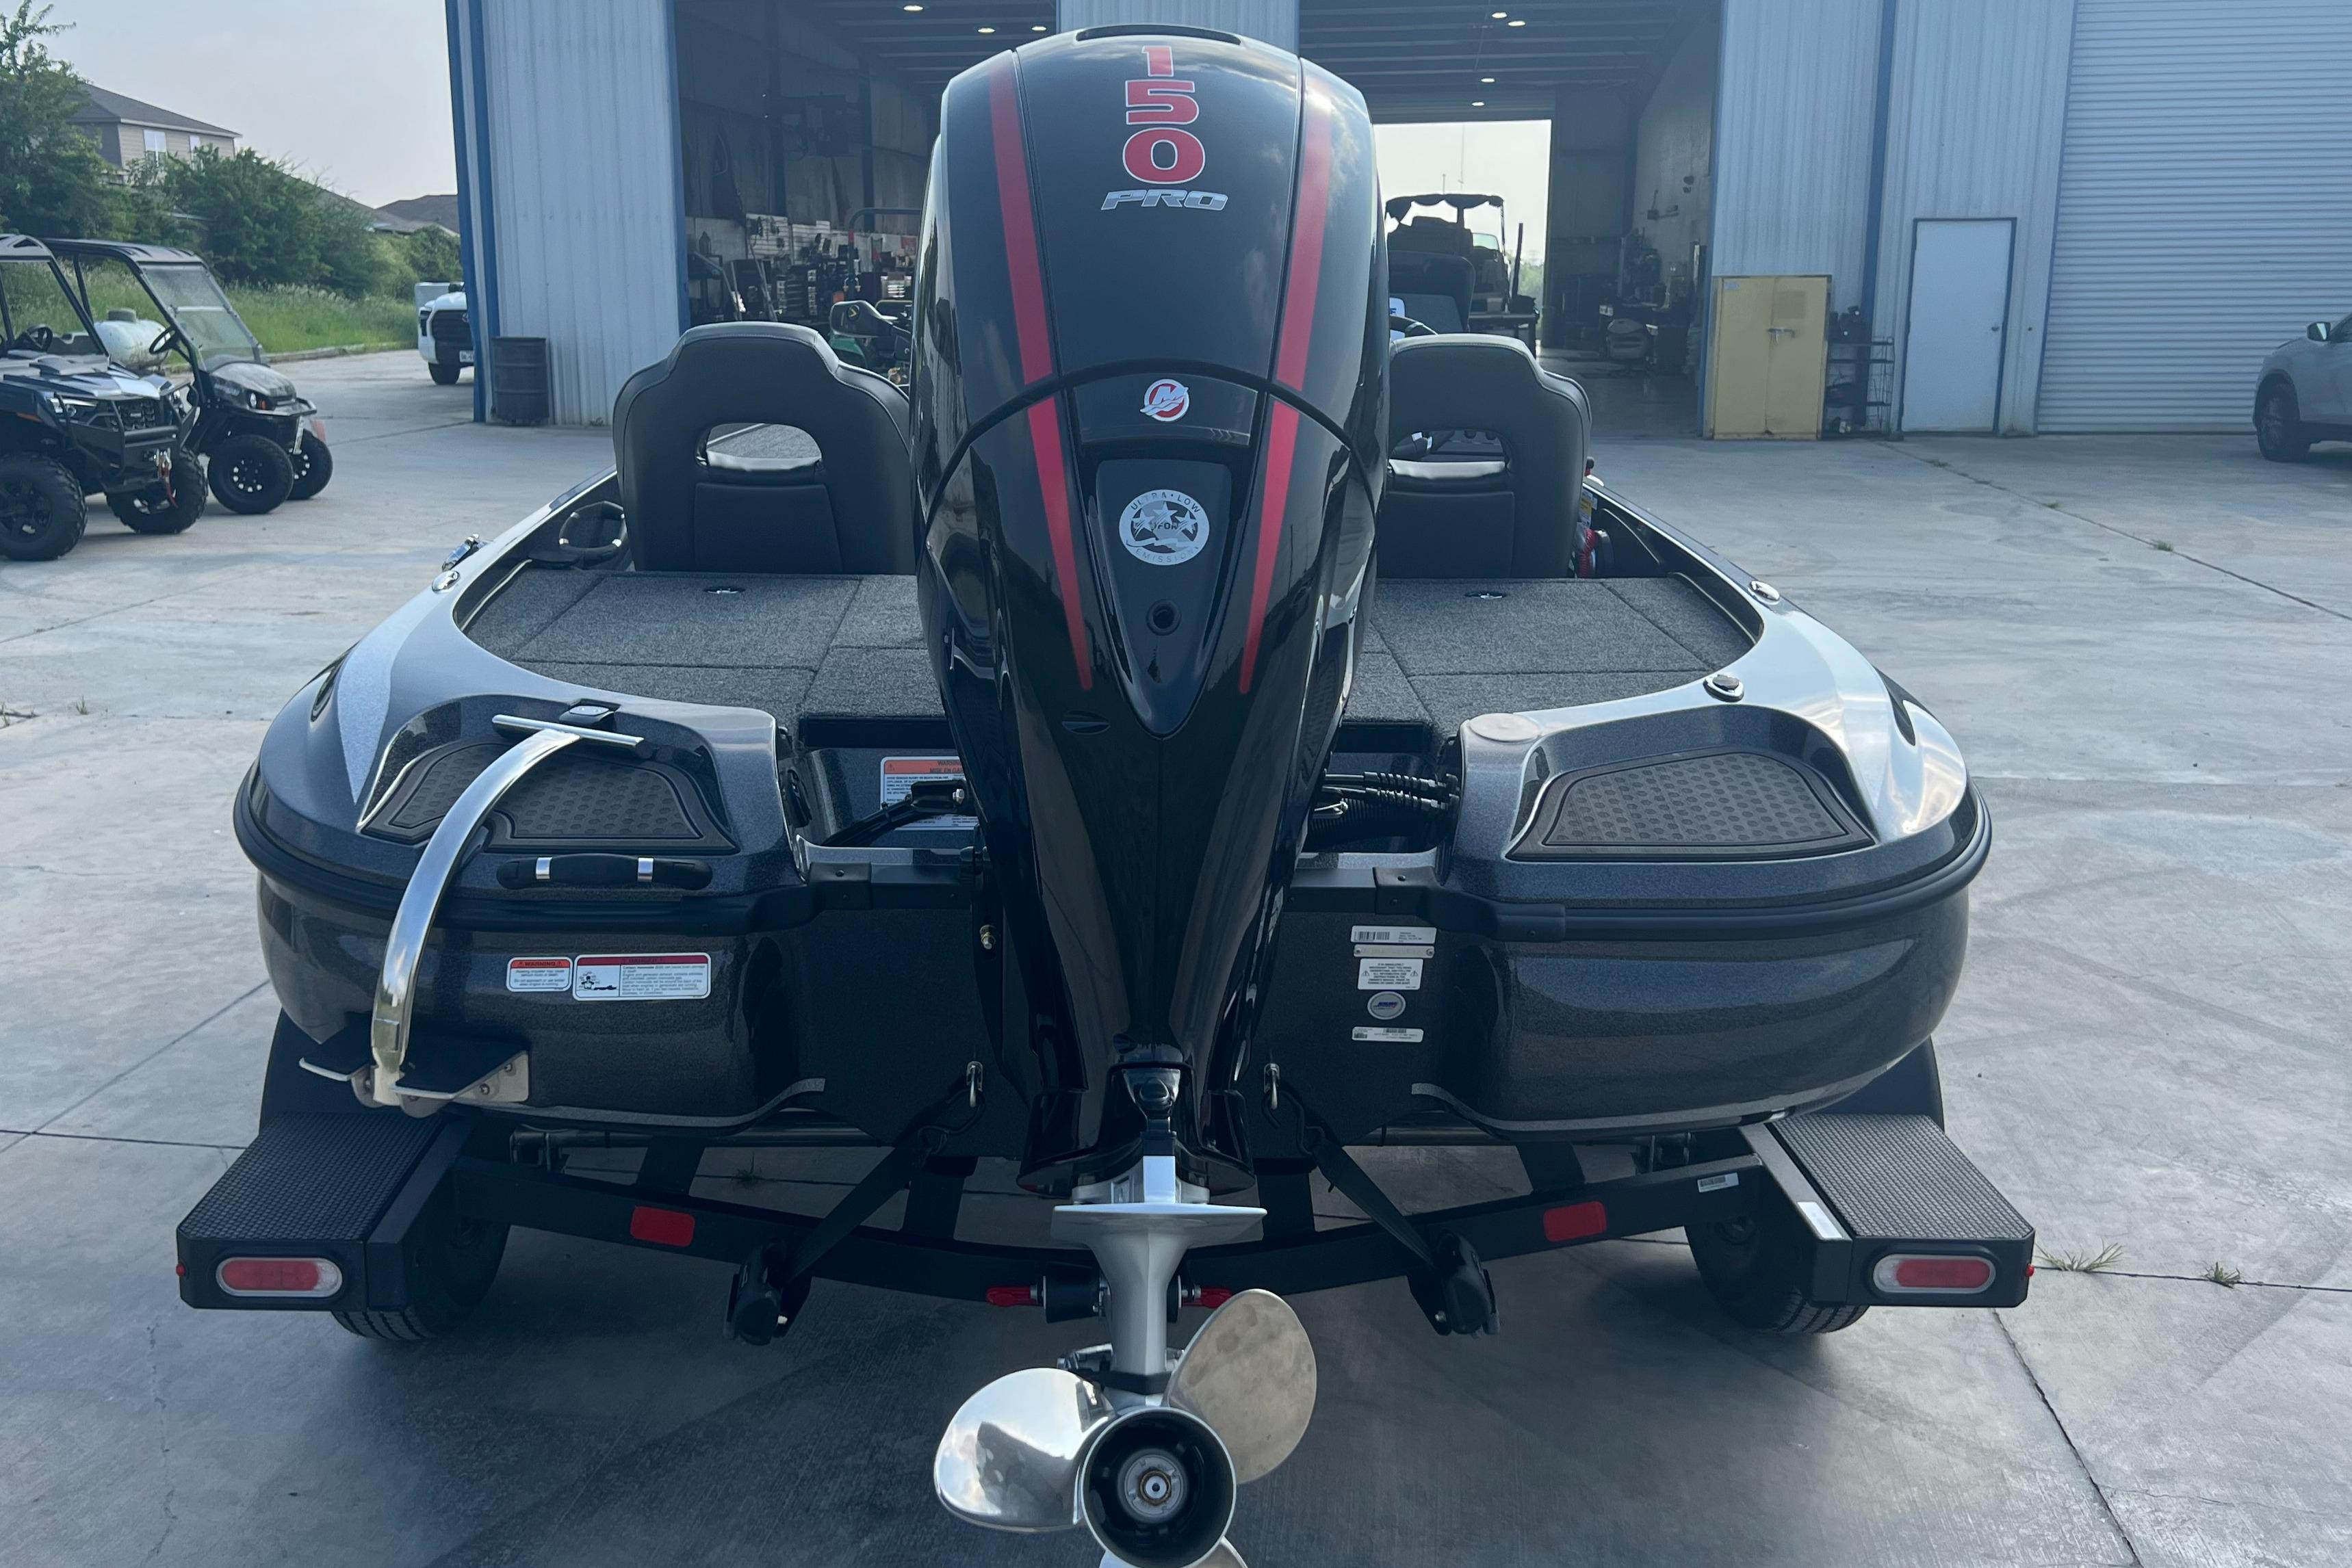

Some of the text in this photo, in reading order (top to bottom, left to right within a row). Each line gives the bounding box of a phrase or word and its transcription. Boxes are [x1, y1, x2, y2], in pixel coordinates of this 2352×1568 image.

[1122, 45, 1206, 184] 150
[1100, 189, 1229, 211] PRO
[1130, 492, 1202, 513] ULTRA LOW
